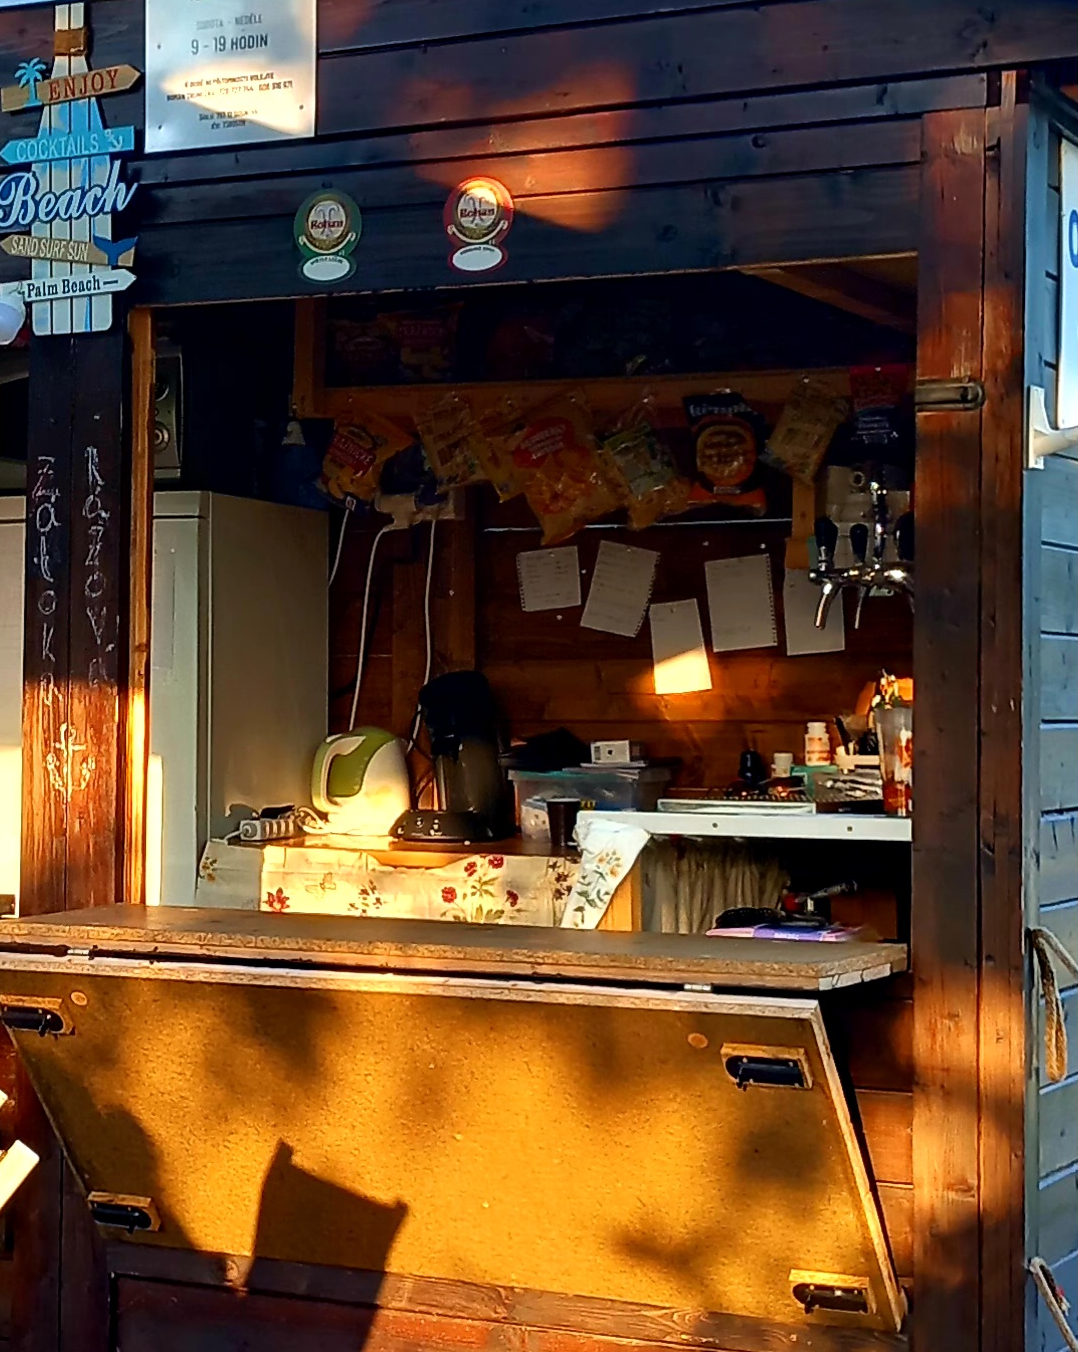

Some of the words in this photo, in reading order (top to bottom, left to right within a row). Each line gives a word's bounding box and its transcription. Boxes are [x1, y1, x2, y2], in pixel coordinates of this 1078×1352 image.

[191, 38, 199, 55] 9
[213, 35, 226, 53] 19
[231, 33, 269, 51] HODIN
[48, 68, 120, 102] ENJOY
[16, 132, 100, 163] COCKTAILS
[11, 235, 39, 258] SAND
[39, 237, 67, 260] SURF
[68, 240, 90, 262] SUN
[26, 278, 59, 299] Palm
[62, 274, 102, 295] Beach
